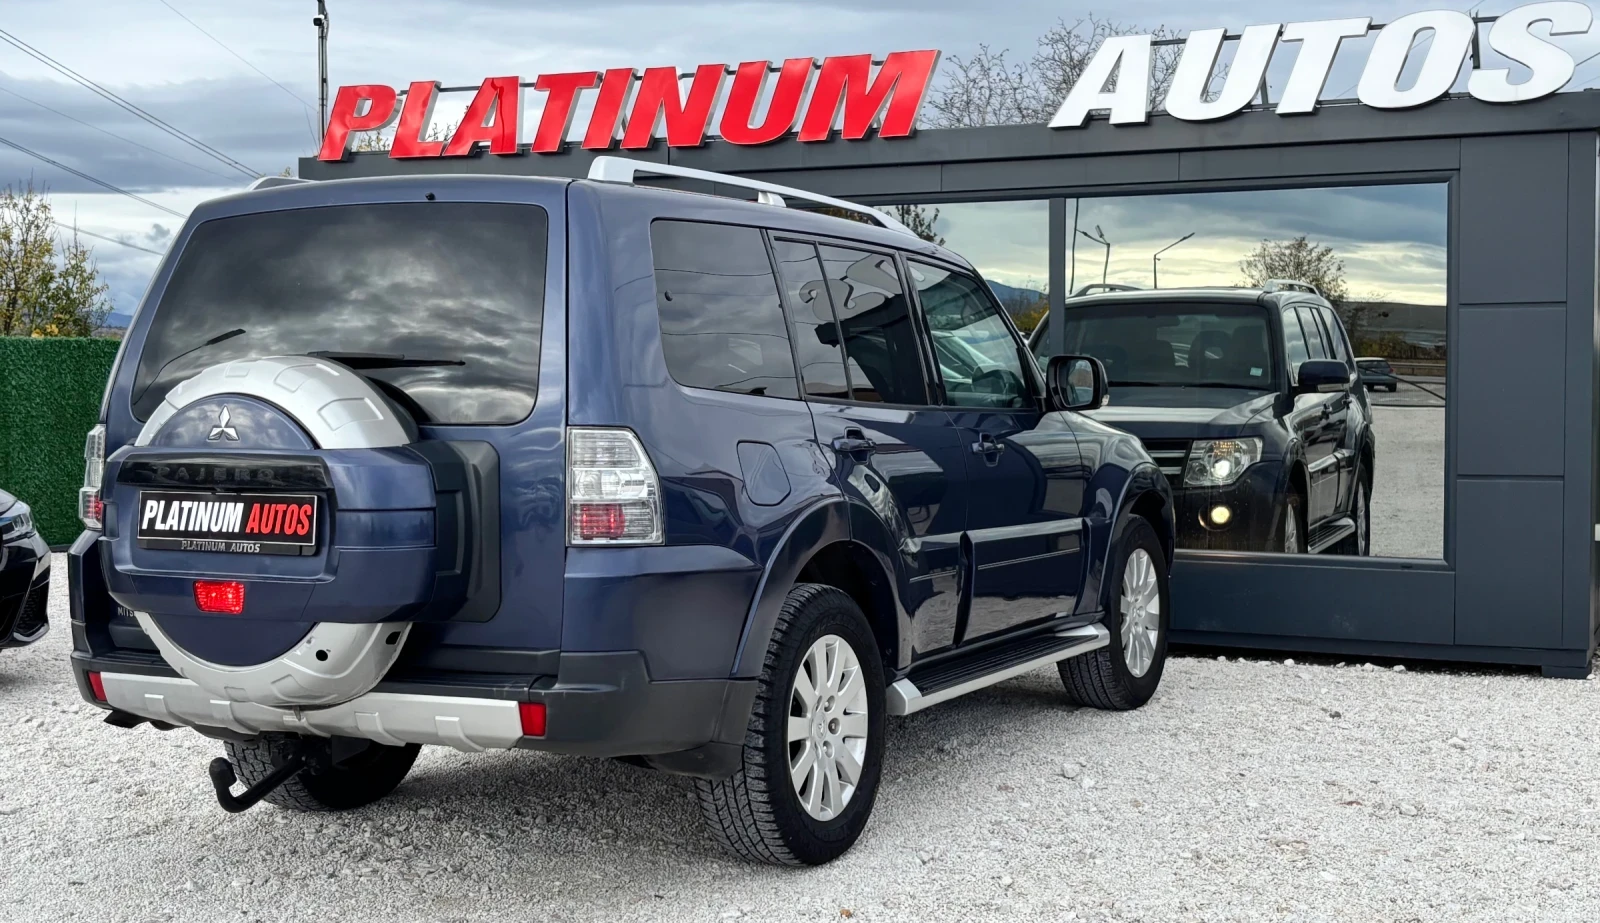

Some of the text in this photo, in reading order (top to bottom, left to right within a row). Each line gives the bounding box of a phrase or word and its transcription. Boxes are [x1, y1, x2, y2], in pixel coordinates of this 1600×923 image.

[317, 1, 1593, 161] PLATINUM AUTOS
[157, 466, 275, 482] PAJERO
[141, 499, 312, 536] PLATINUM AUTOS
[181, 540, 261, 553] PLATINUM AUTOS
[117, 606, 136, 617] MITS
